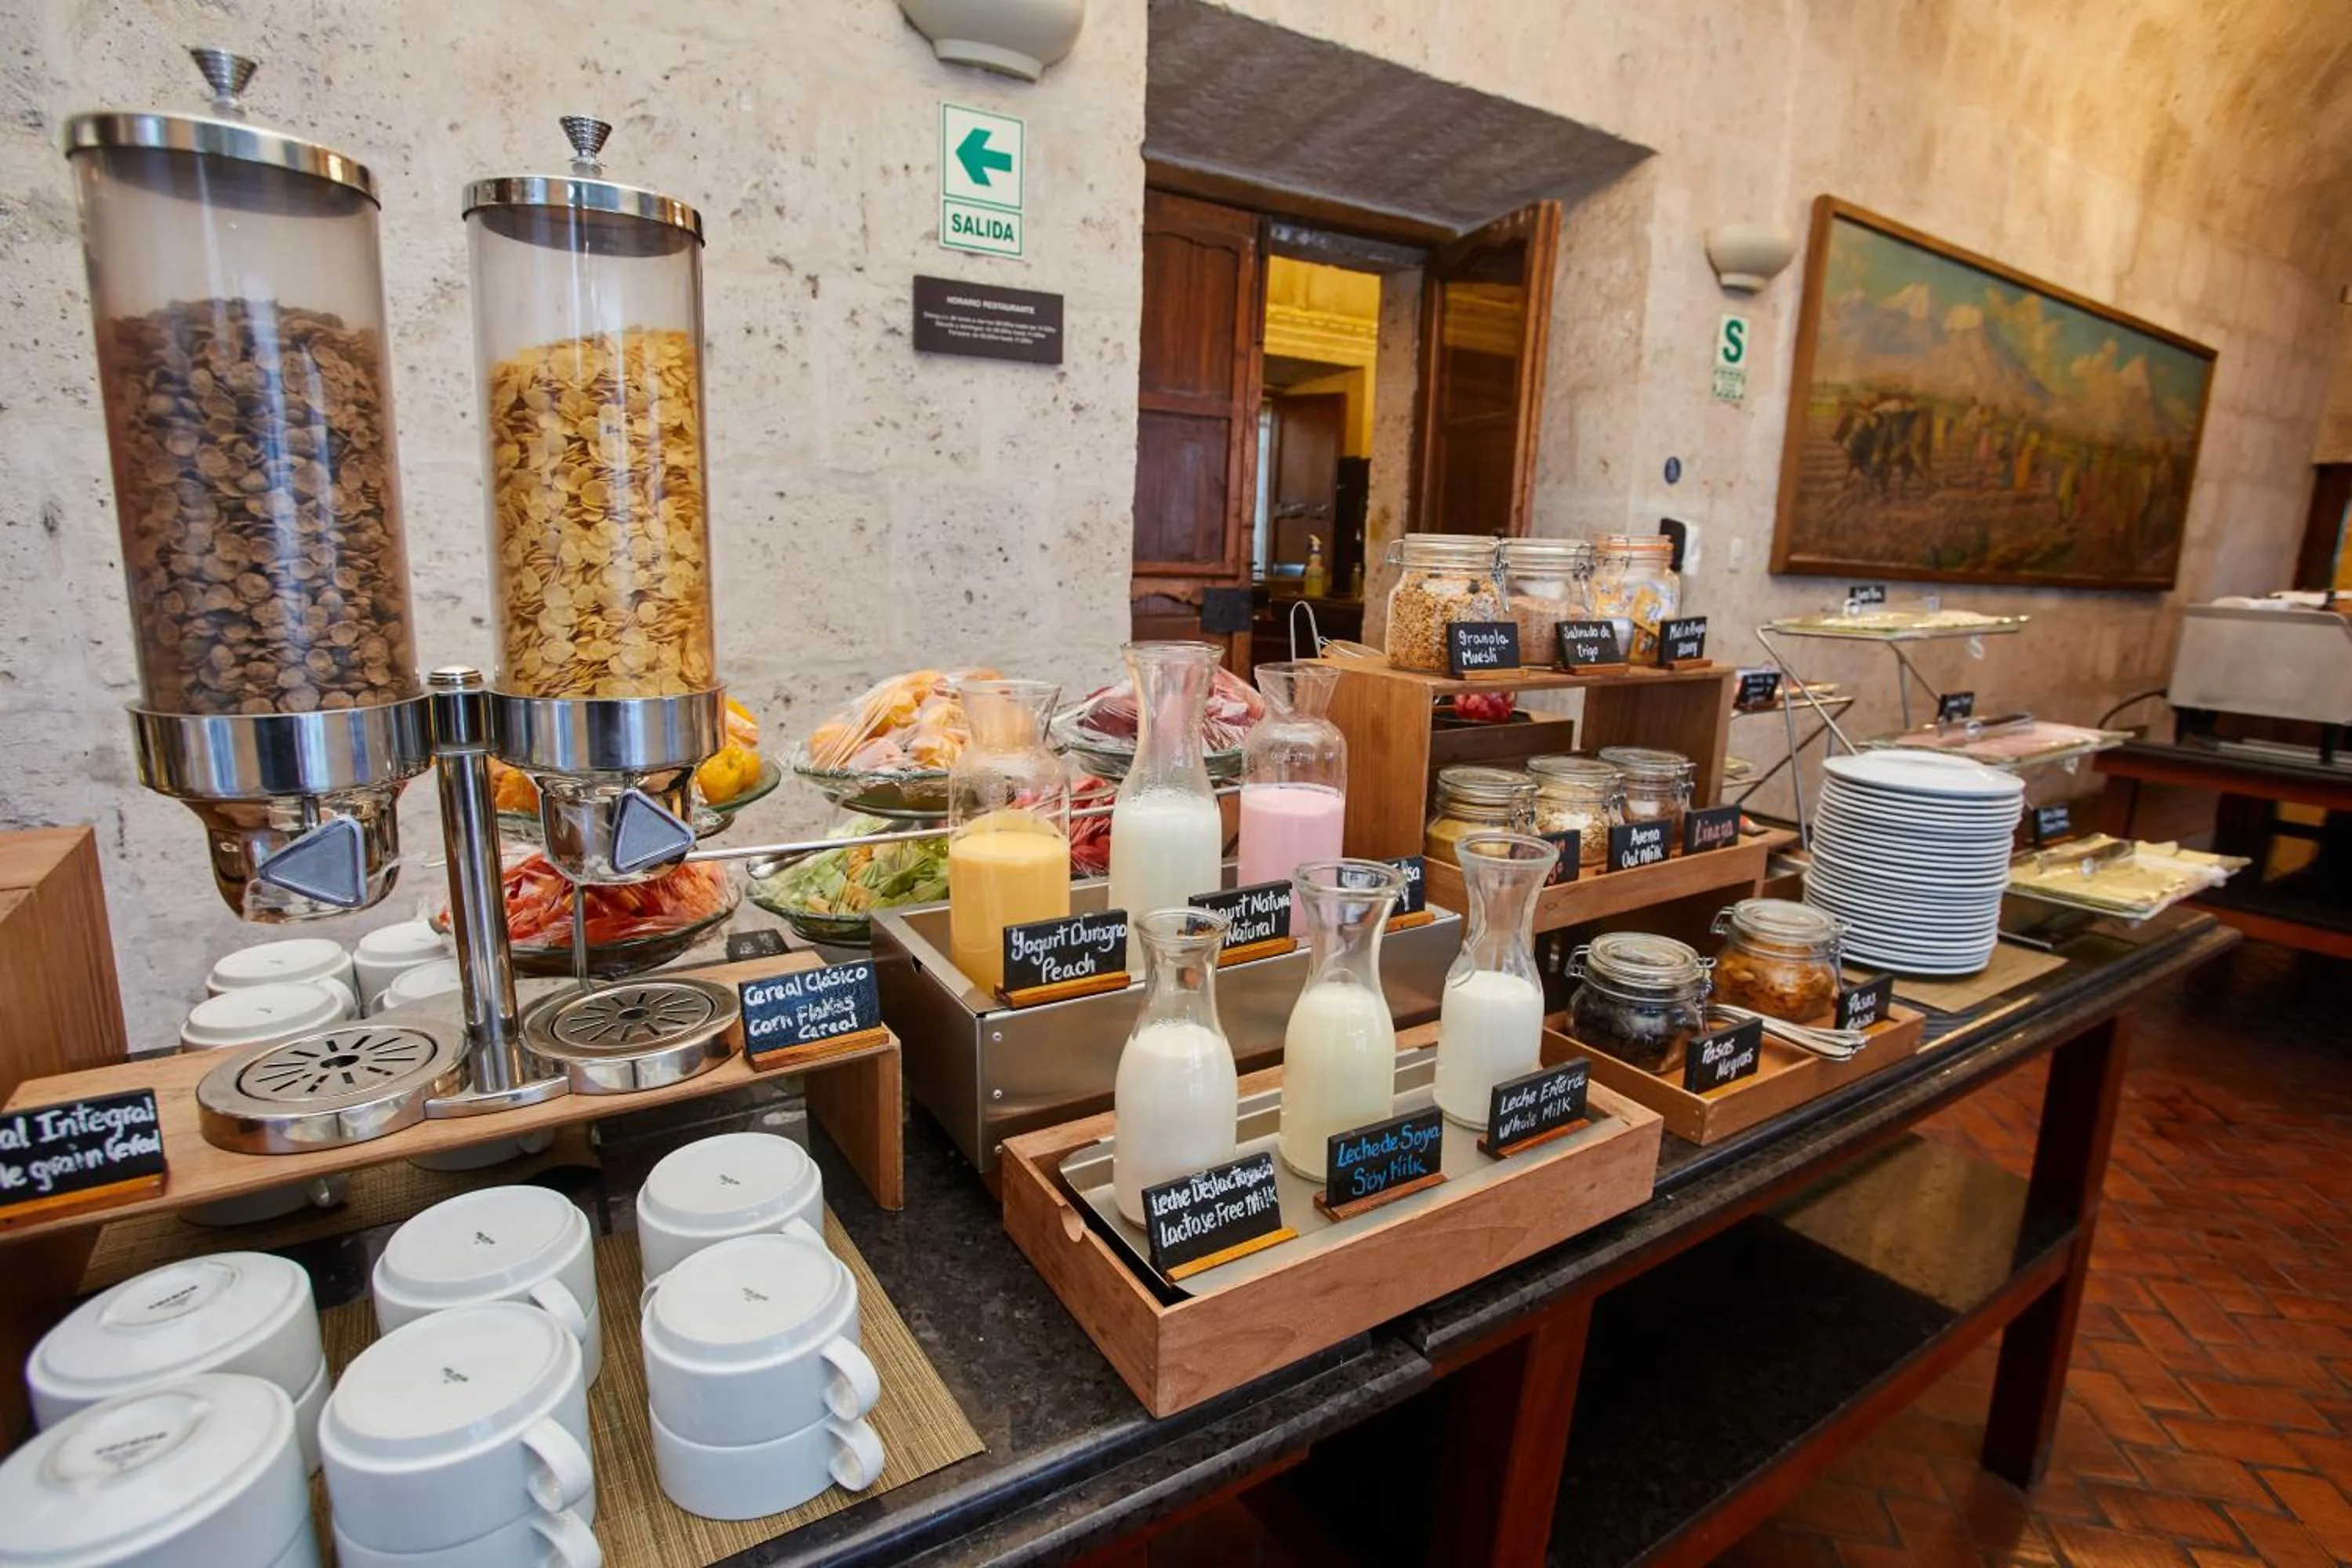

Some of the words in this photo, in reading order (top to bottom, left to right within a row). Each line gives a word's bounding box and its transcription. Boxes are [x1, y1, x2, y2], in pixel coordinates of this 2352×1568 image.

[952, 212, 1014, 242] SALIDA
[1722, 319, 1744, 364] S
[1577, 643, 1599, 662] trigo
[1225, 913, 1275, 946] Natural
[1011, 924, 1069, 966] Yogurt
[1042, 952, 1096, 983] Peach
[745, 976, 802, 1006] Cereal
[1500, 1087, 1537, 1116] Leche
[1539, 1073, 1587, 1103] Entera
[34, 1096, 155, 1142] Integral
[1399, 1123, 1442, 1153] Soya
[29, 1143, 103, 1192] grain
[1352, 1167, 1387, 1196] Soy
[1151, 1188, 1192, 1217] Leche
[1214, 1200, 1245, 1227] Free
